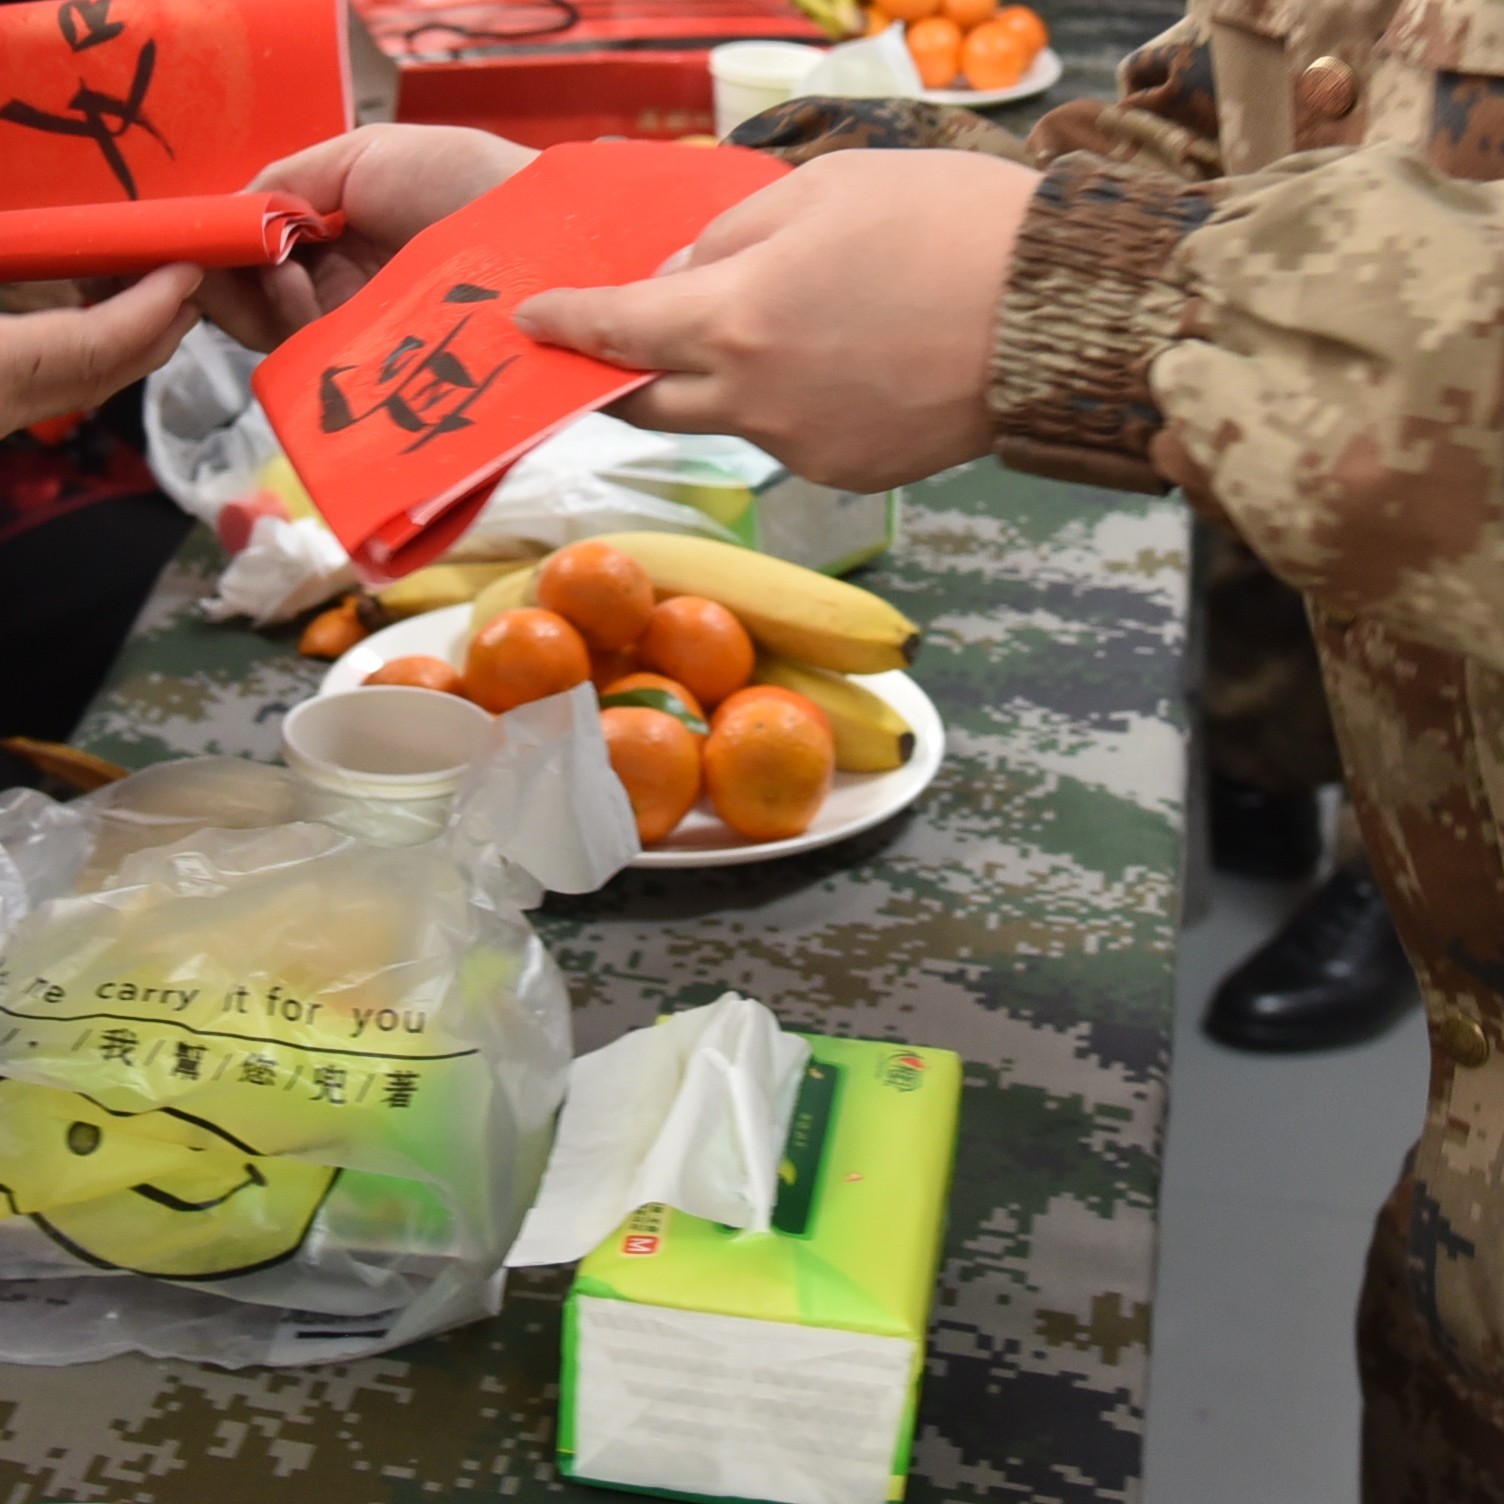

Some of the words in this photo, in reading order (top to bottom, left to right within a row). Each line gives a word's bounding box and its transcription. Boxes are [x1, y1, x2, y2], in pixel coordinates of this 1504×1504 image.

[96, 980, 201, 1012] carry
[222, 984, 251, 1014] it
[265, 985, 324, 1025] for
[349, 1006, 426, 1038] you
